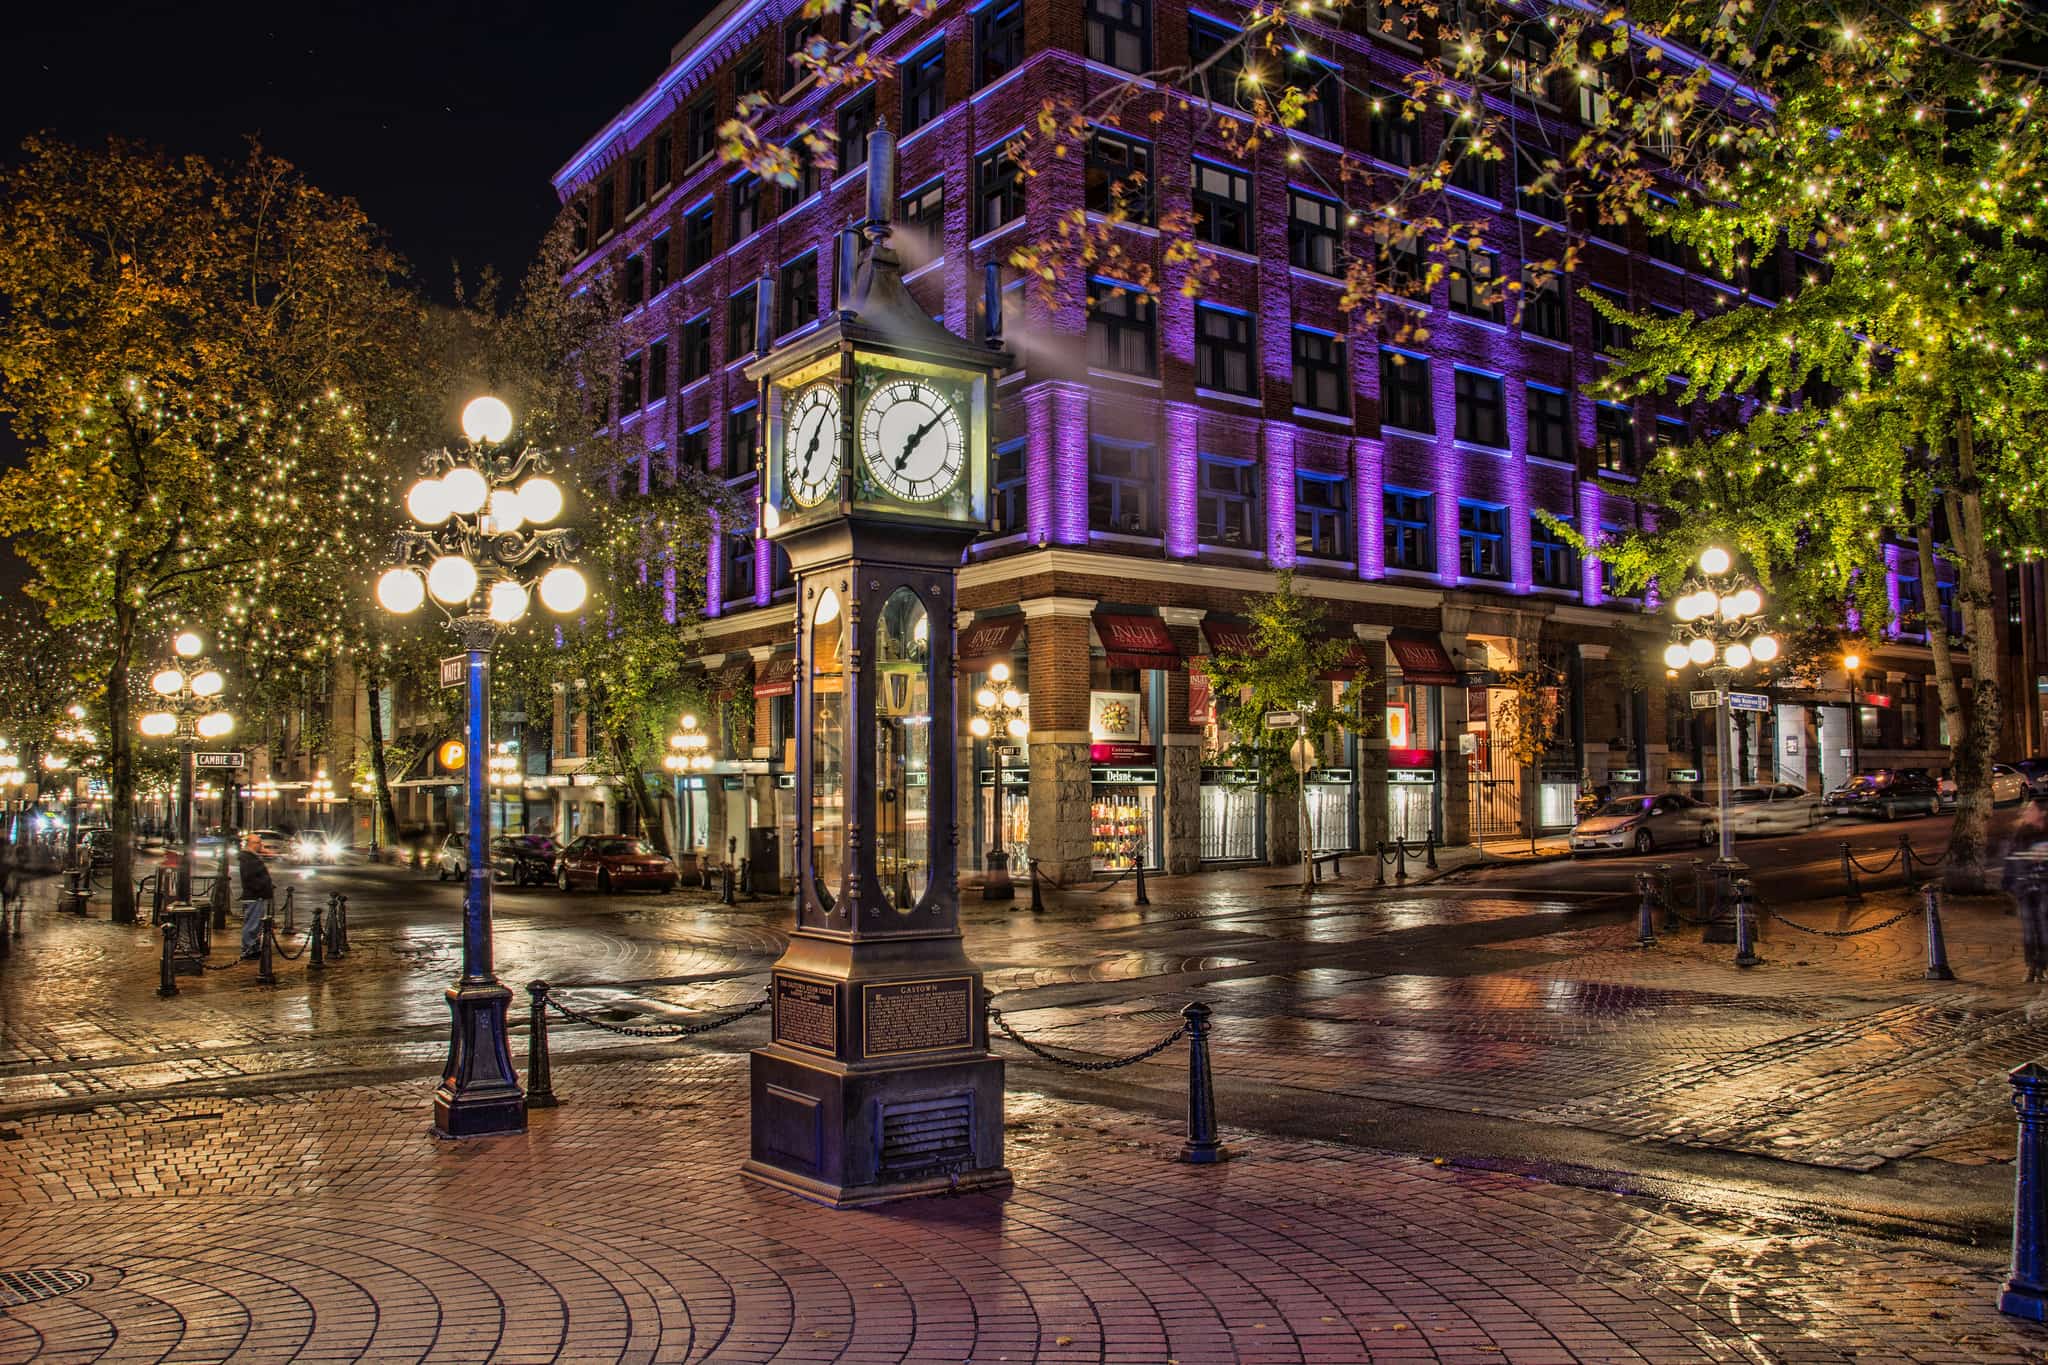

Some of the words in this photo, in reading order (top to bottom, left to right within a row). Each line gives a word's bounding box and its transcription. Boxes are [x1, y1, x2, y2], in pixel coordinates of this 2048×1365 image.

[1217, 632, 1253, 648] INUI
[443, 661, 462, 683] WATER
[199, 755, 229, 765] CAMBIE
[447, 745, 462, 765] P
